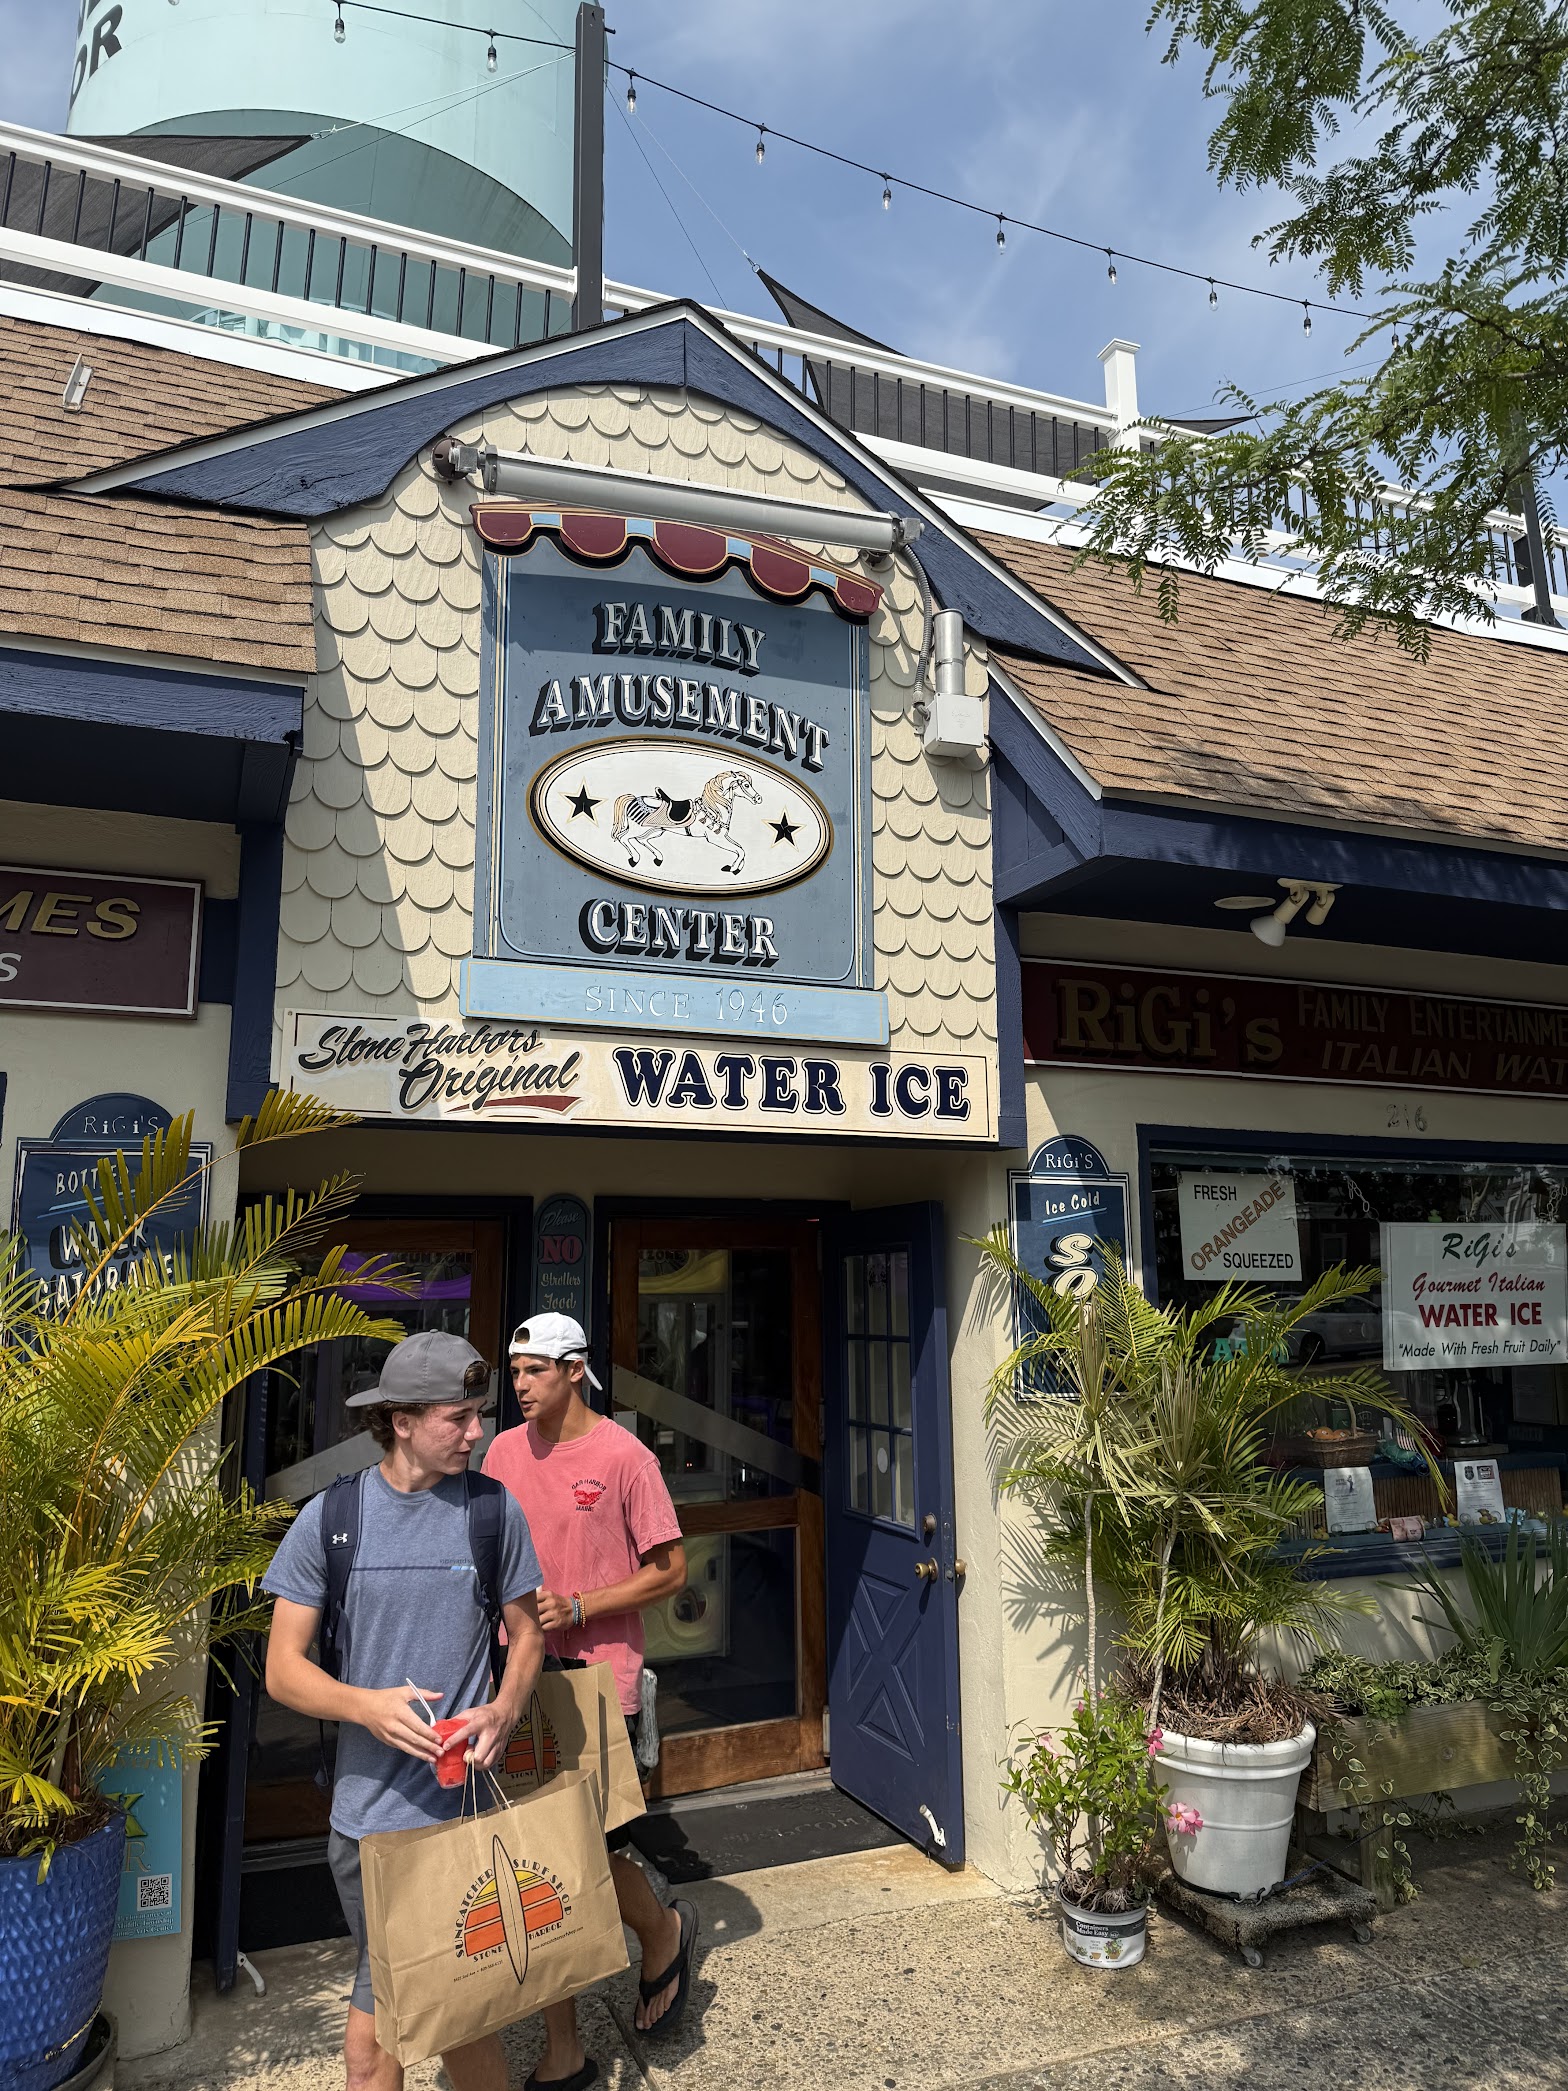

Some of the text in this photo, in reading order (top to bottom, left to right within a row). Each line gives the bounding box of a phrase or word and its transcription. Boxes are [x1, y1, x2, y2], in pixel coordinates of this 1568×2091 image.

[600, 602, 766, 674] FAMILY
[534, 673, 830, 771] AMUSEMENT
[583, 899, 779, 962] CENTER
[585, 985, 788, 1026] SINCE 1946
[1297, 987, 1390, 1032] FAMILY
[299, 1023, 543, 1070] Stone Harbors
[1321, 1039, 1472, 1080] ITALIAN
[399, 1051, 580, 1111] Original
[612, 1047, 971, 1121] WATER ICE
[1045, 1191, 1100, 1215] Ice Cold
[1193, 1184, 1237, 1201] FRESH
[542, 1208, 581, 1232] Please
[1190, 1180, 1286, 1271] ORANGEADE
[539, 1235, 583, 1265] NO
[1222, 1252, 1294, 1270] SQUEEZED
[541, 1272, 581, 1287] Strollers
[1412, 1272, 1546, 1301] Gourmet Italian
[541, 1291, 577, 1310] Food
[1418, 1302, 1543, 1328] WATER ICE
[1441, 1342, 1467, 1355] With
[1471, 1341, 1499, 1355] Fresh
[1503, 1340, 1526, 1354] Fruit
[454, 1858, 573, 1958] SUNCATCHER SURF SHOP
[473, 1921, 562, 1962] STONE HARBOR
[1075, 1920, 1109, 1932] Containers
[1076, 1926, 1093, 1936] Made
[1094, 1930, 1109, 1938] Easy
